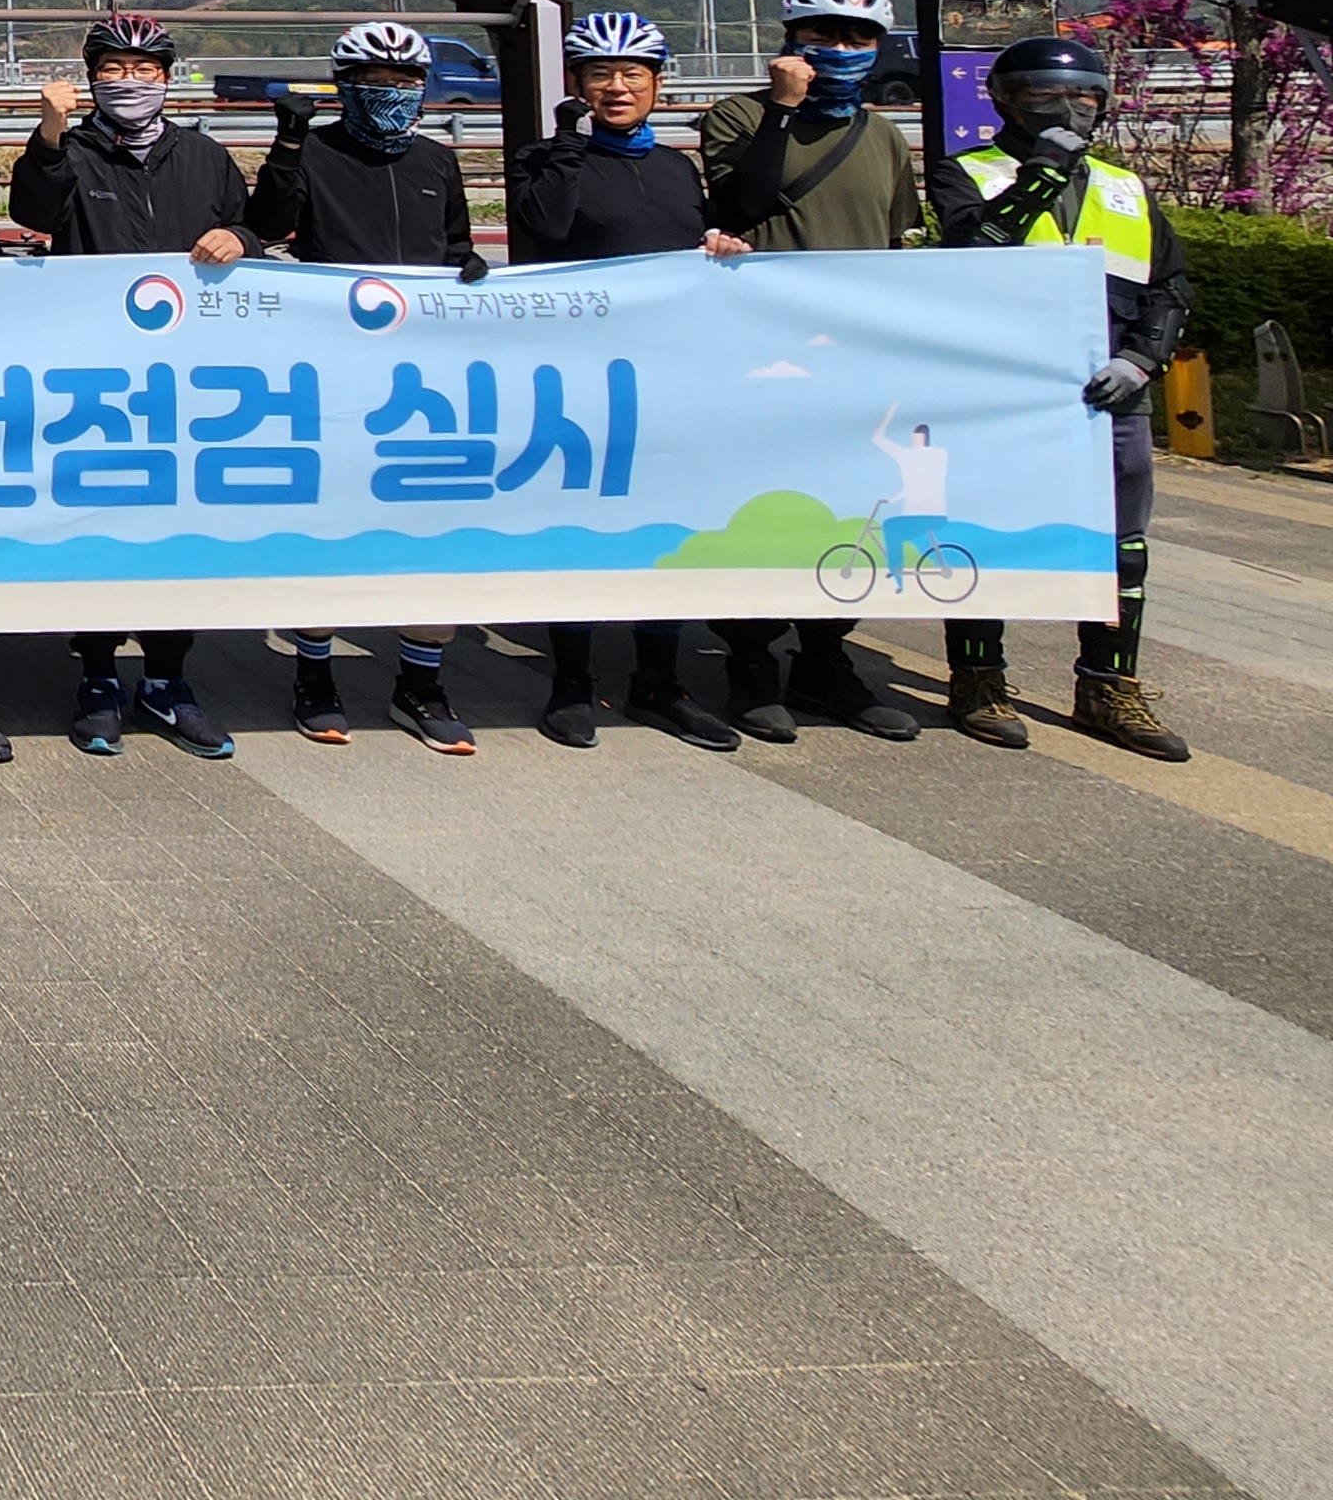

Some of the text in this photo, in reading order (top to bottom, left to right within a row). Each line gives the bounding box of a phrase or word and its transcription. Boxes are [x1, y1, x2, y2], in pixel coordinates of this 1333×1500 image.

[197, 290, 282, 318] 환경부
[417, 290, 611, 319] 대구지방환경청
[363, 357, 639, 503] 실시
